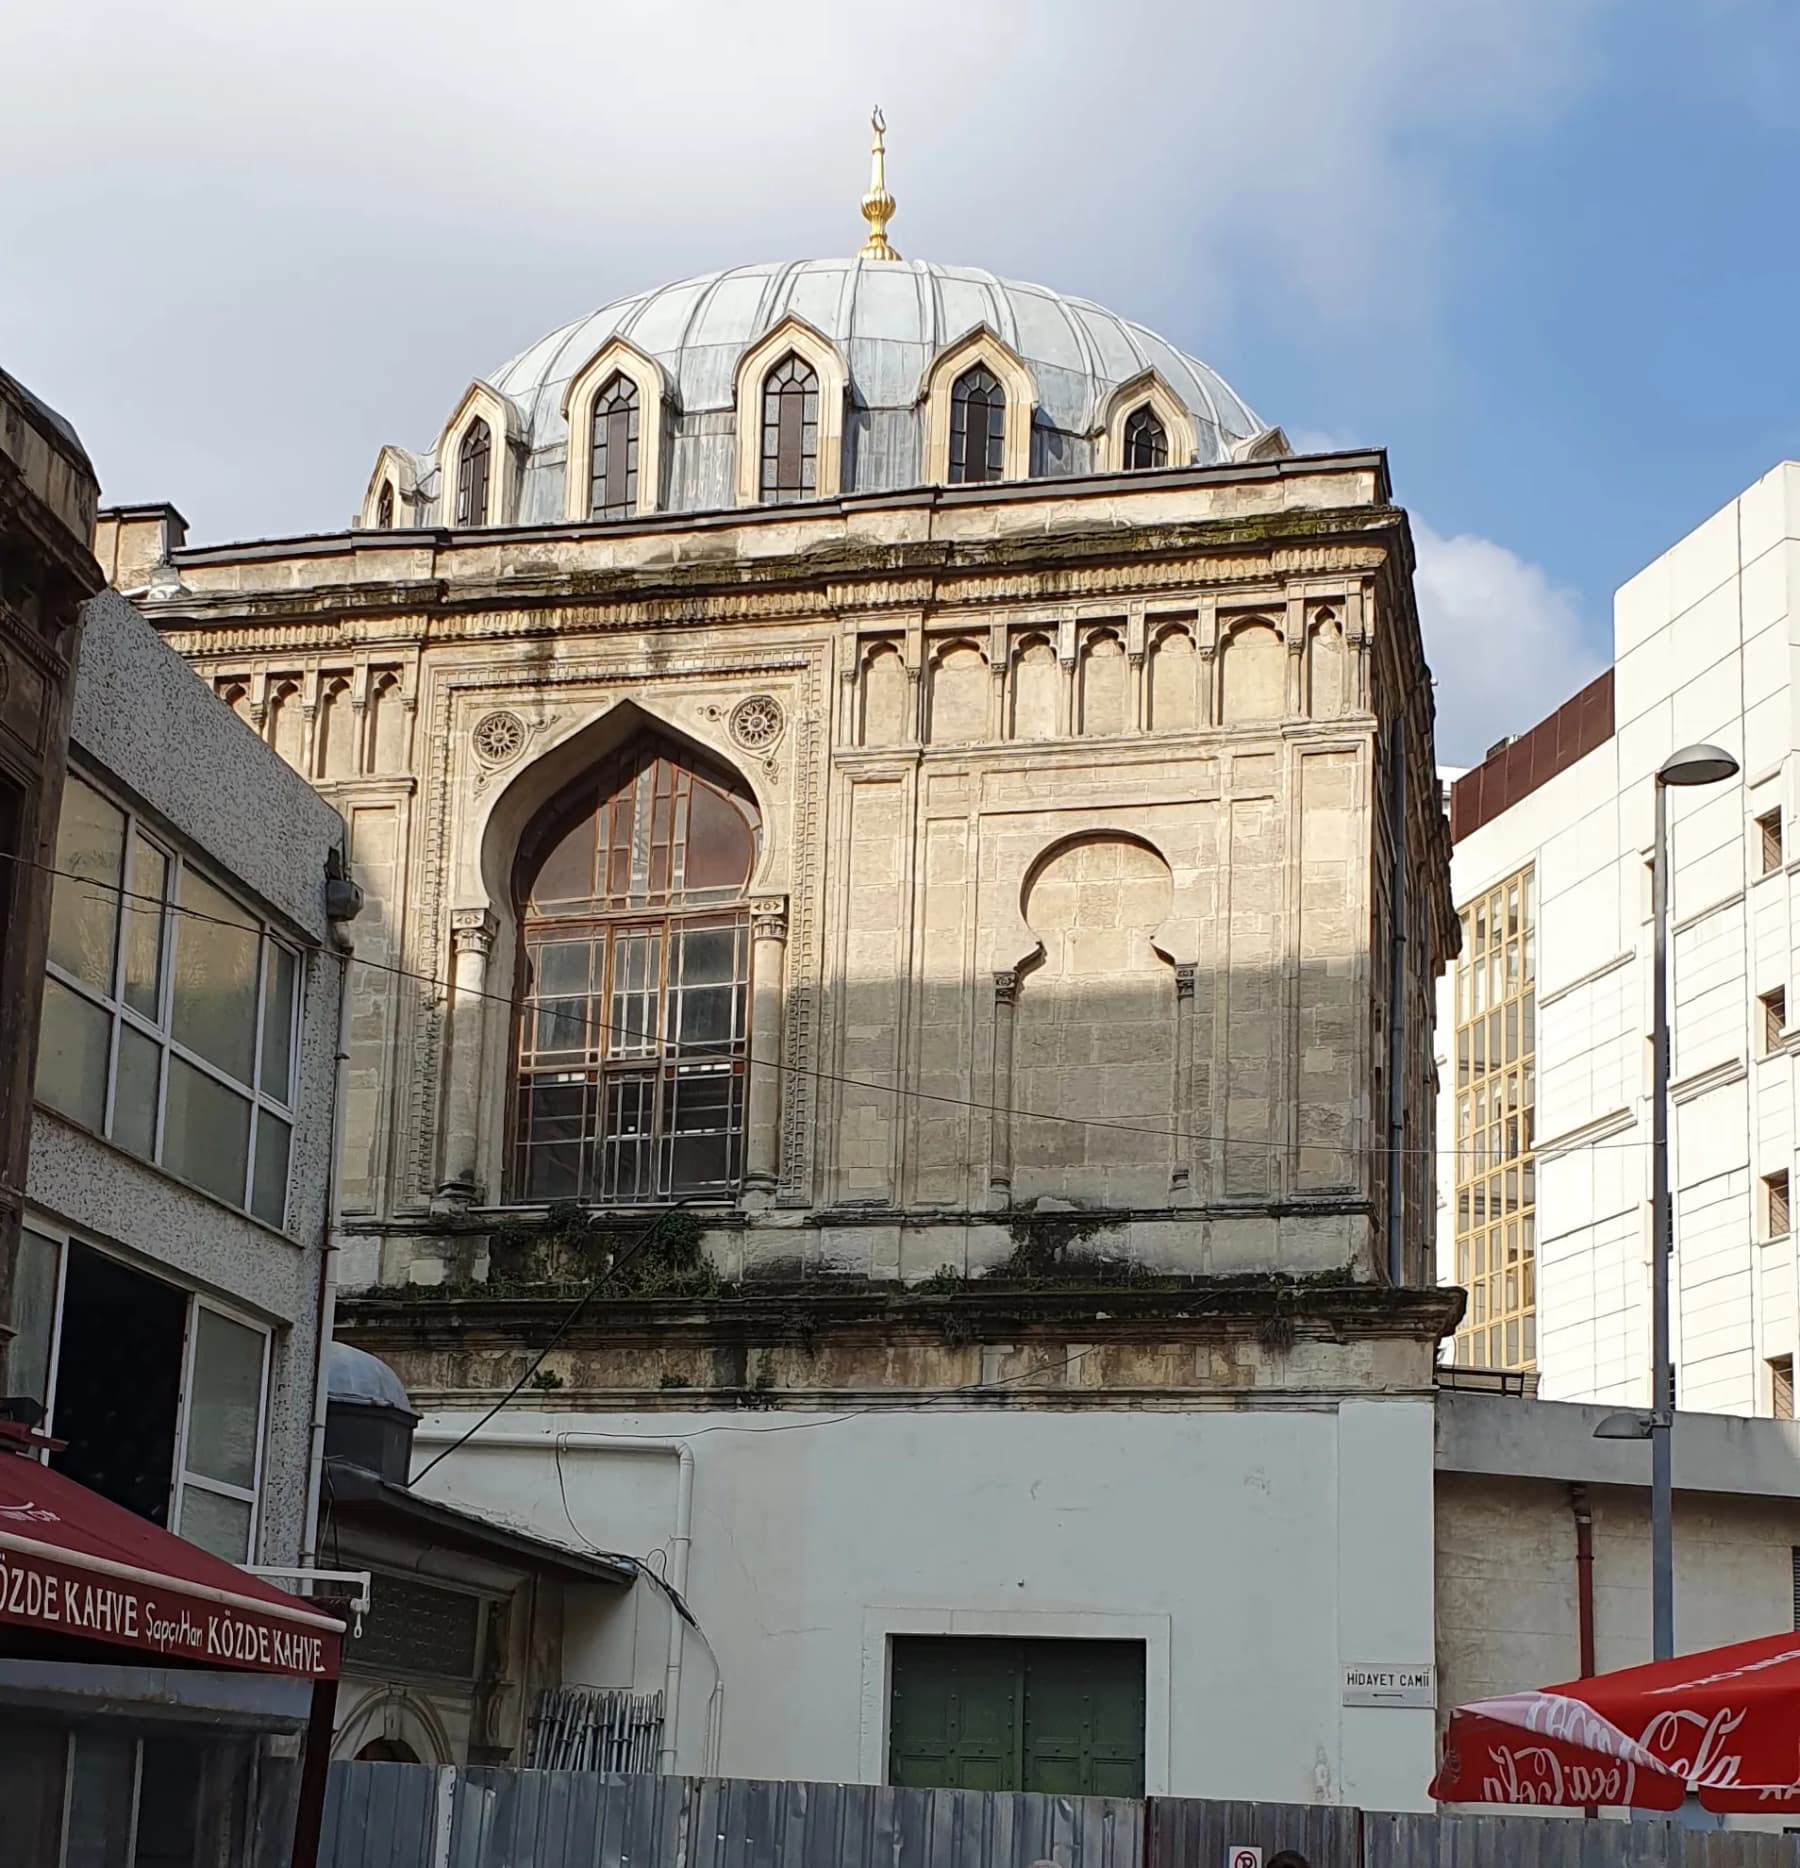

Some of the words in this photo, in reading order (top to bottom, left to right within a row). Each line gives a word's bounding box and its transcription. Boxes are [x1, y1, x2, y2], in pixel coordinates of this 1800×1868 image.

[64, 1581, 139, 1638] KAHVE
[207, 1609, 271, 1664] KÖZDE
[272, 1629, 326, 1673] KAHVE
[1346, 1669, 1395, 1687] HİDAYET
